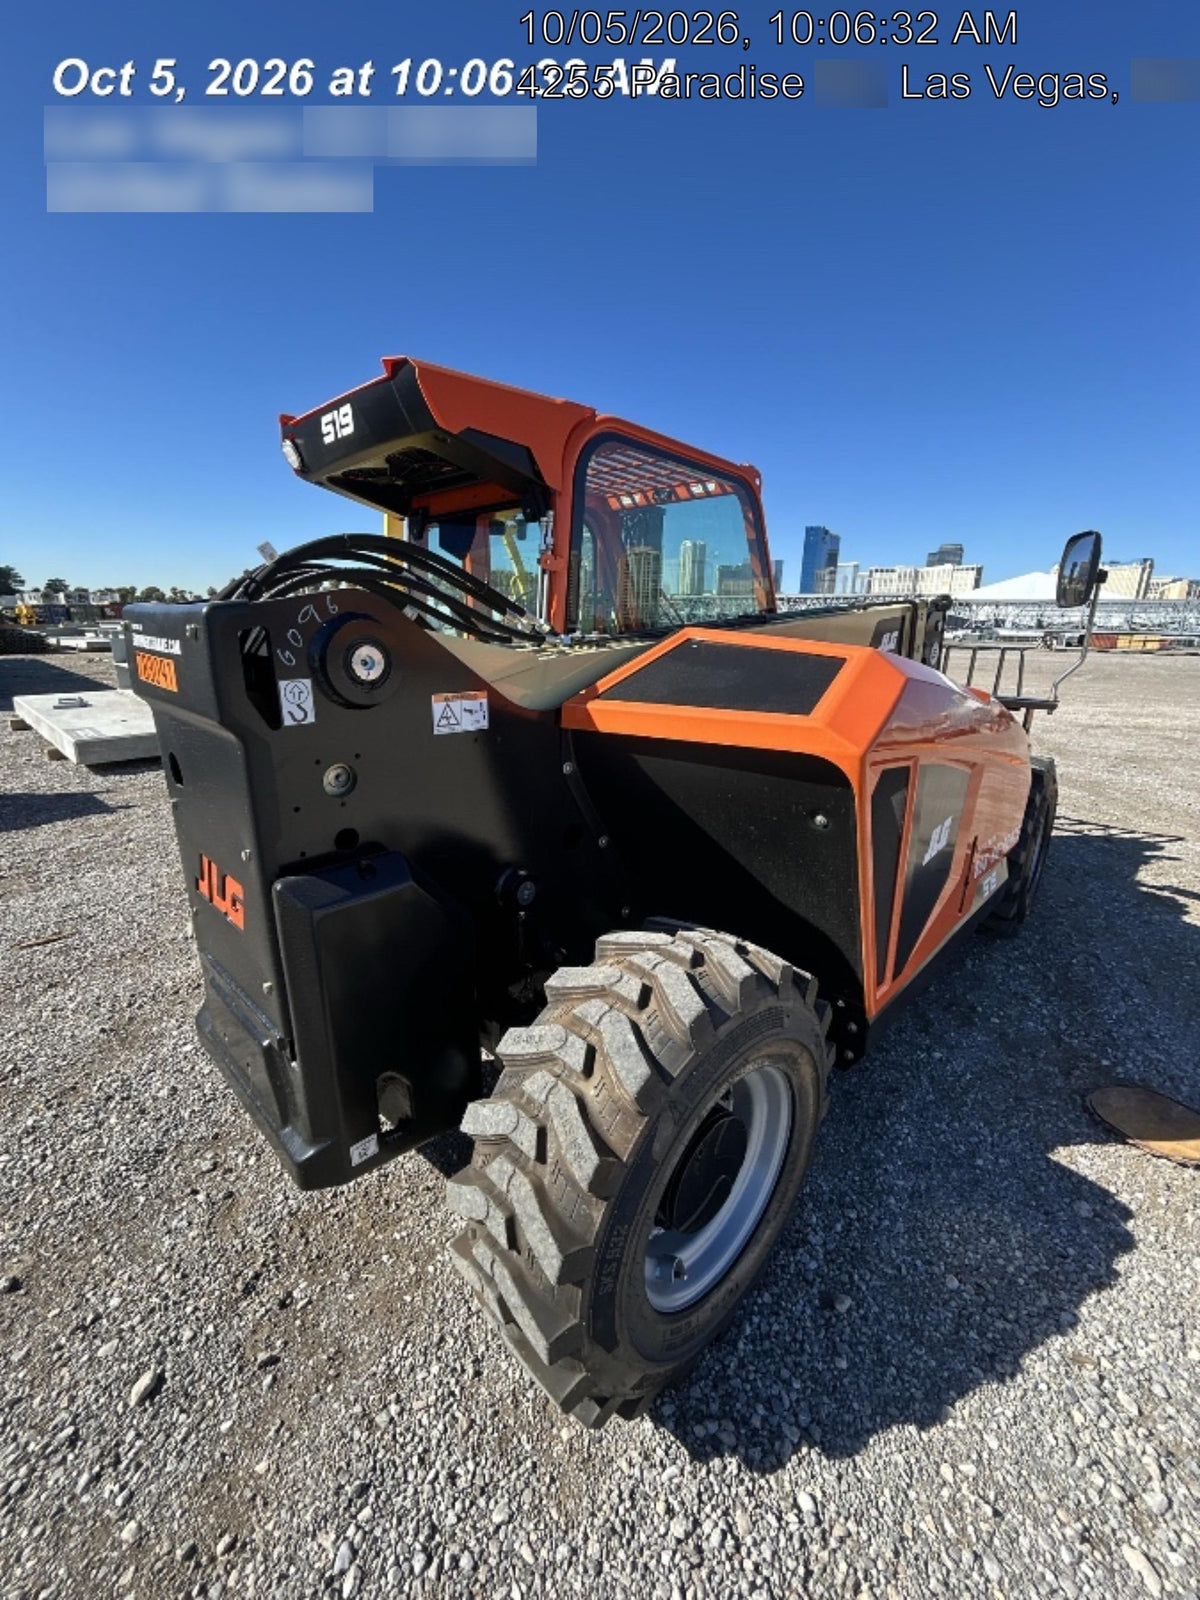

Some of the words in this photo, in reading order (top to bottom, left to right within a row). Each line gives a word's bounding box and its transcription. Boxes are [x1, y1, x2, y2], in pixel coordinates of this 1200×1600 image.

[321, 403, 354, 445] S19
[922, 816, 952, 867] JLG
[196, 853, 244, 931] JLG
